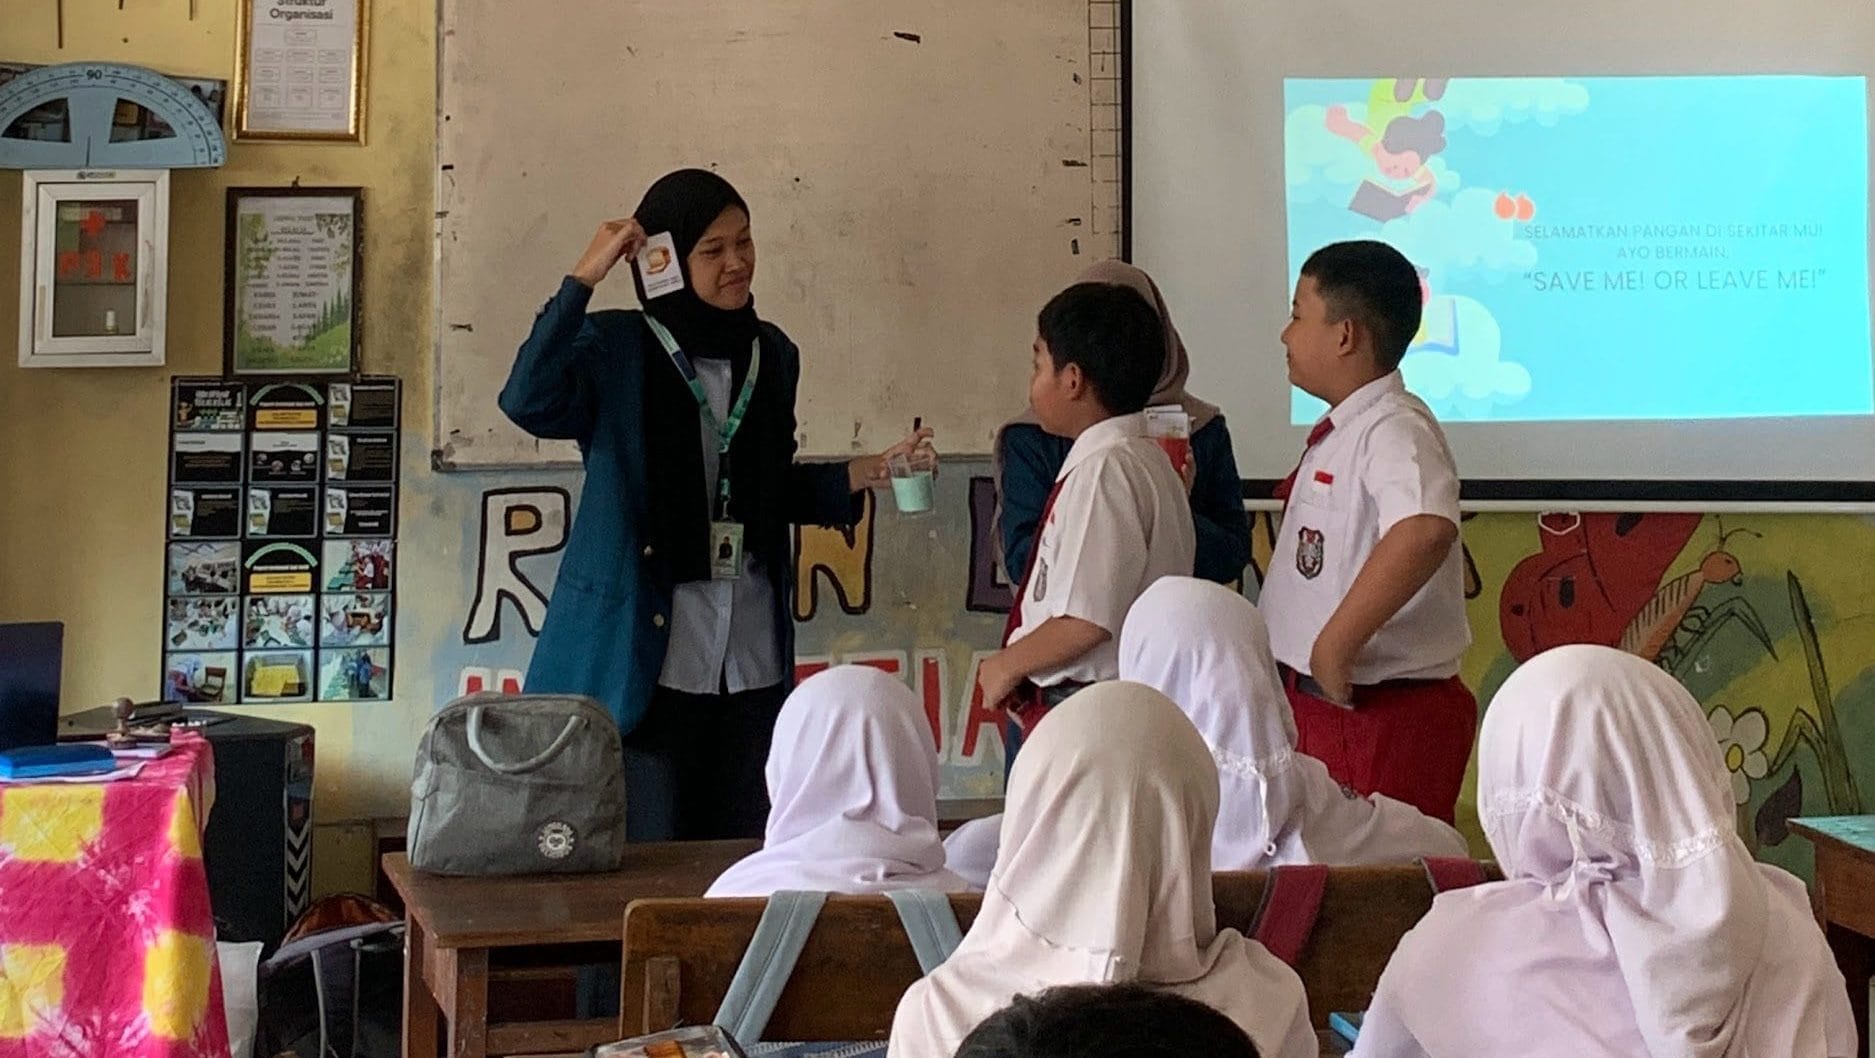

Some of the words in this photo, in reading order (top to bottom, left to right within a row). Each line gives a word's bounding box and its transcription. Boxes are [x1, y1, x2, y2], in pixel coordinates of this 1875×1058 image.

[269, 8, 334, 21] Organisasi
[86, 69, 102, 80] 90
[1524, 225, 1628, 239] SELAMATKAN
[1633, 224, 1701, 238] PANGAN
[1705, 224, 1722, 238] DI
[1727, 224, 1788, 238] SEKITAR
[1616, 245, 1650, 259] AYO
[1604, 270, 1645, 291] ME!
[1654, 270, 1688, 290] OR
[1698, 269, 1768, 290] LEAVE
